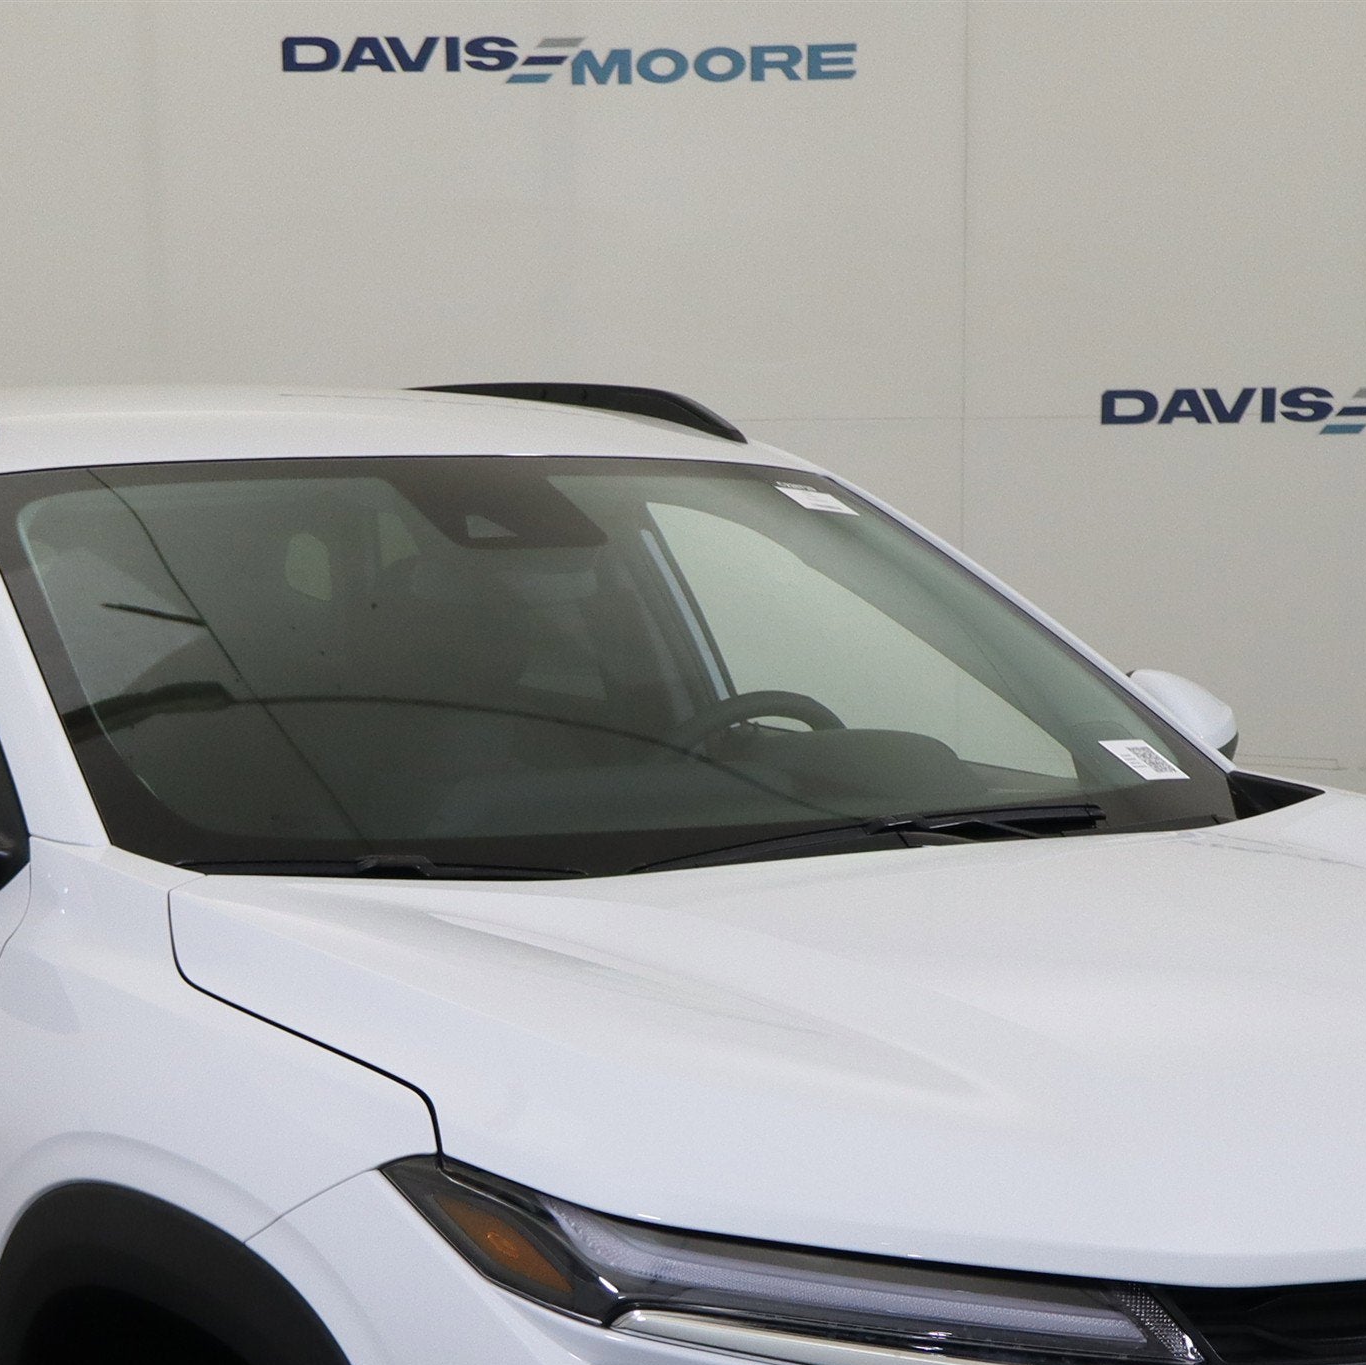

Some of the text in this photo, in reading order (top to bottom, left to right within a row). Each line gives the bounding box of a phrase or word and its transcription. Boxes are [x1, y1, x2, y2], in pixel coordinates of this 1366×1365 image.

[281, 36, 858, 86] DAVIS MOORE
[1100, 386, 1334, 426] DAVIS
